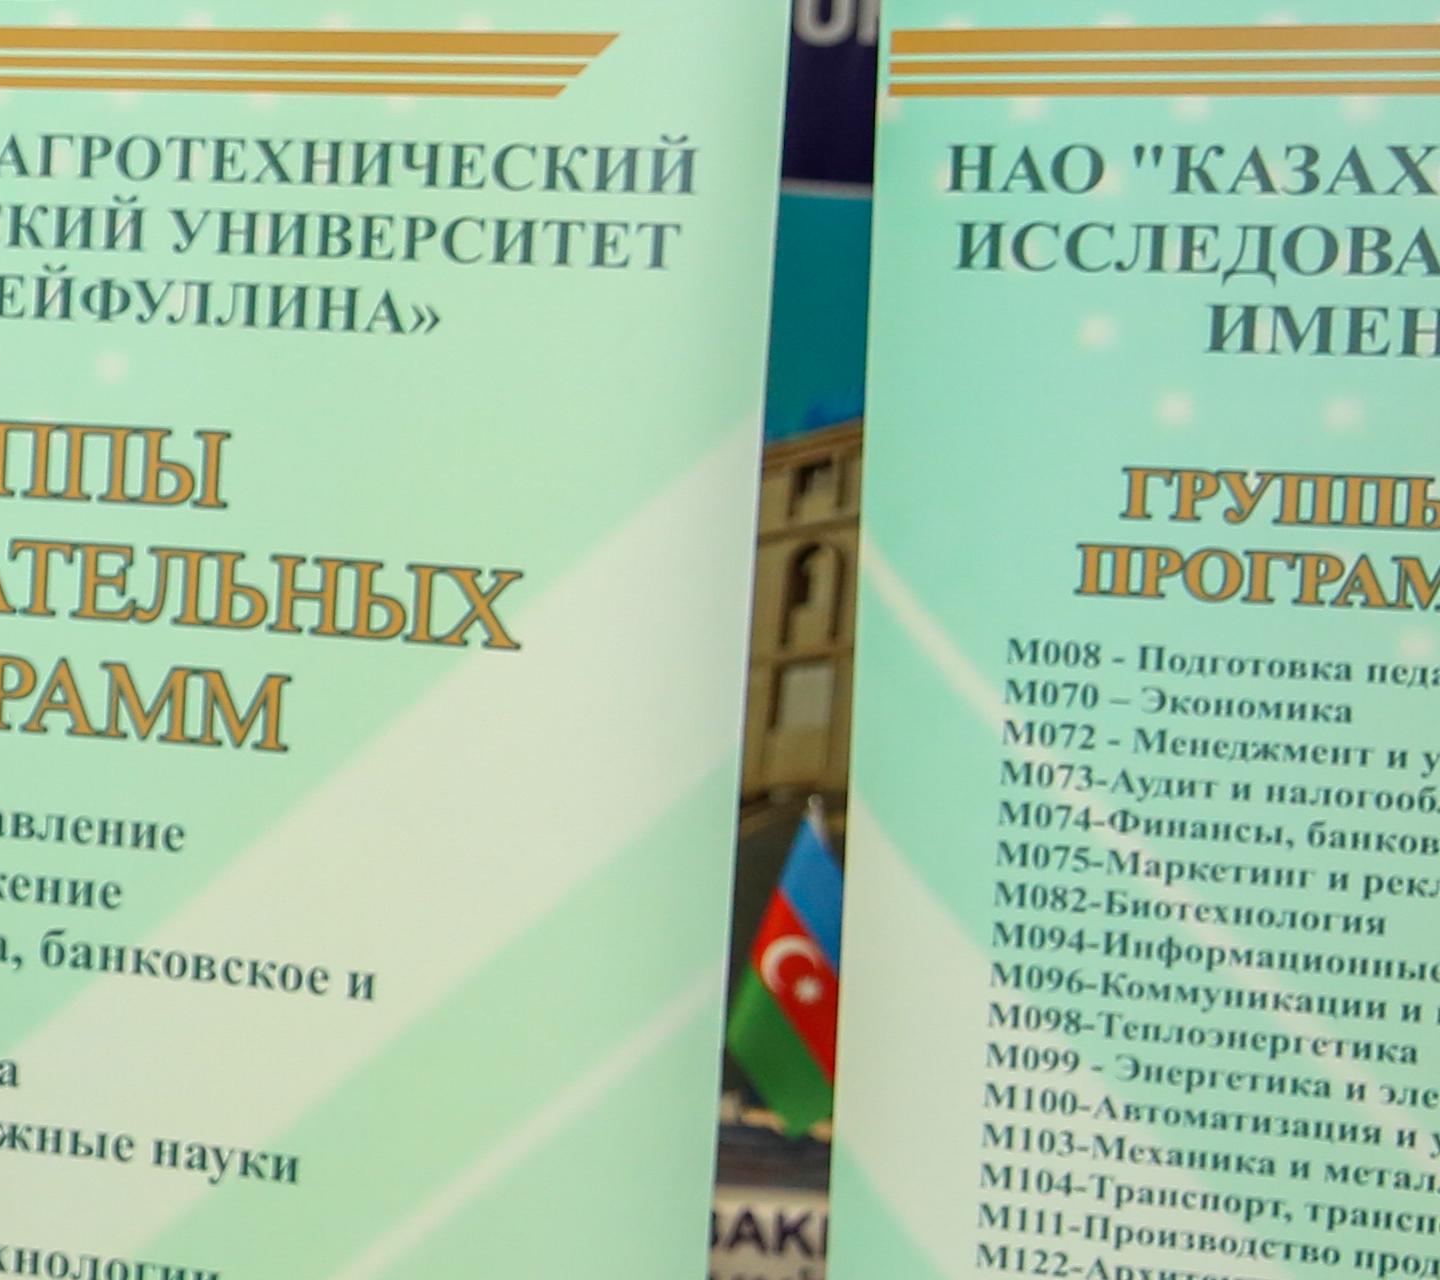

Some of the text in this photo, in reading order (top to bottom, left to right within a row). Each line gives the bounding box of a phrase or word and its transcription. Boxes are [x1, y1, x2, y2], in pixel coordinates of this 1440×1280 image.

[946, 144, 1440, 197] НАО "КАЗАХ
[171, 209, 682, 269] УНИВЕРСИТЕТ
[956, 221, 1440, 287] ИССЛЕДОВА
[1136, 645, 1352, 683] Подготовка
[1140, 686, 1352, 724] Экономика
[1133, 727, 1373, 768] Менеджмент
[40, 927, 329, 995] банковское
[1115, 1053, 1331, 1099] Энергетика
[152, 1135, 301, 1186] науки
